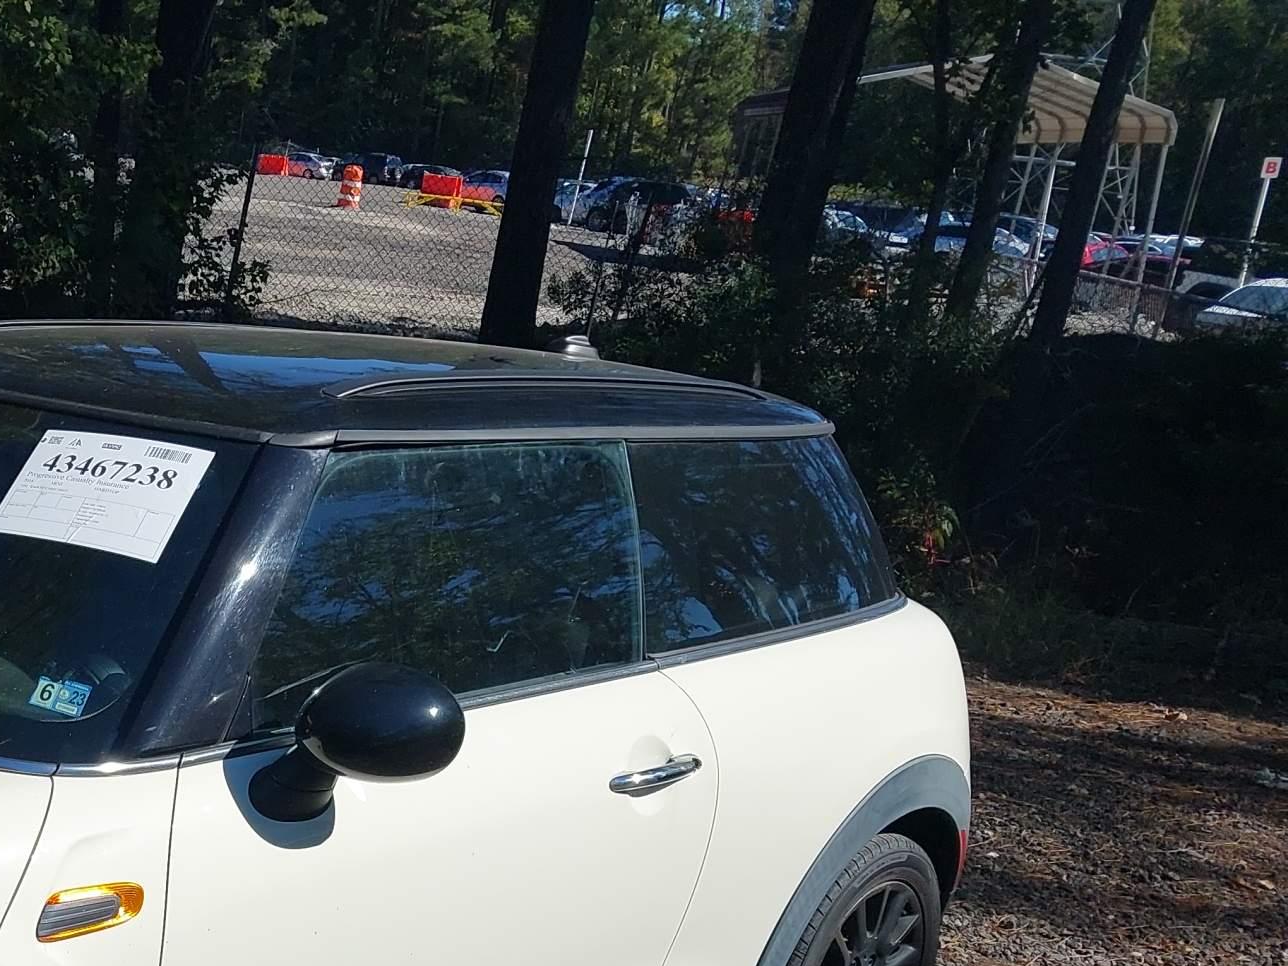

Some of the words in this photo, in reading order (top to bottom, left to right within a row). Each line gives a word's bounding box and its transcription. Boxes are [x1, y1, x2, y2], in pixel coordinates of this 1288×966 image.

[1265, 161, 1278, 174] B
[43, 453, 179, 490] 43467238
[39, 683, 55, 702] 6
[68, 690, 87, 706] 23
